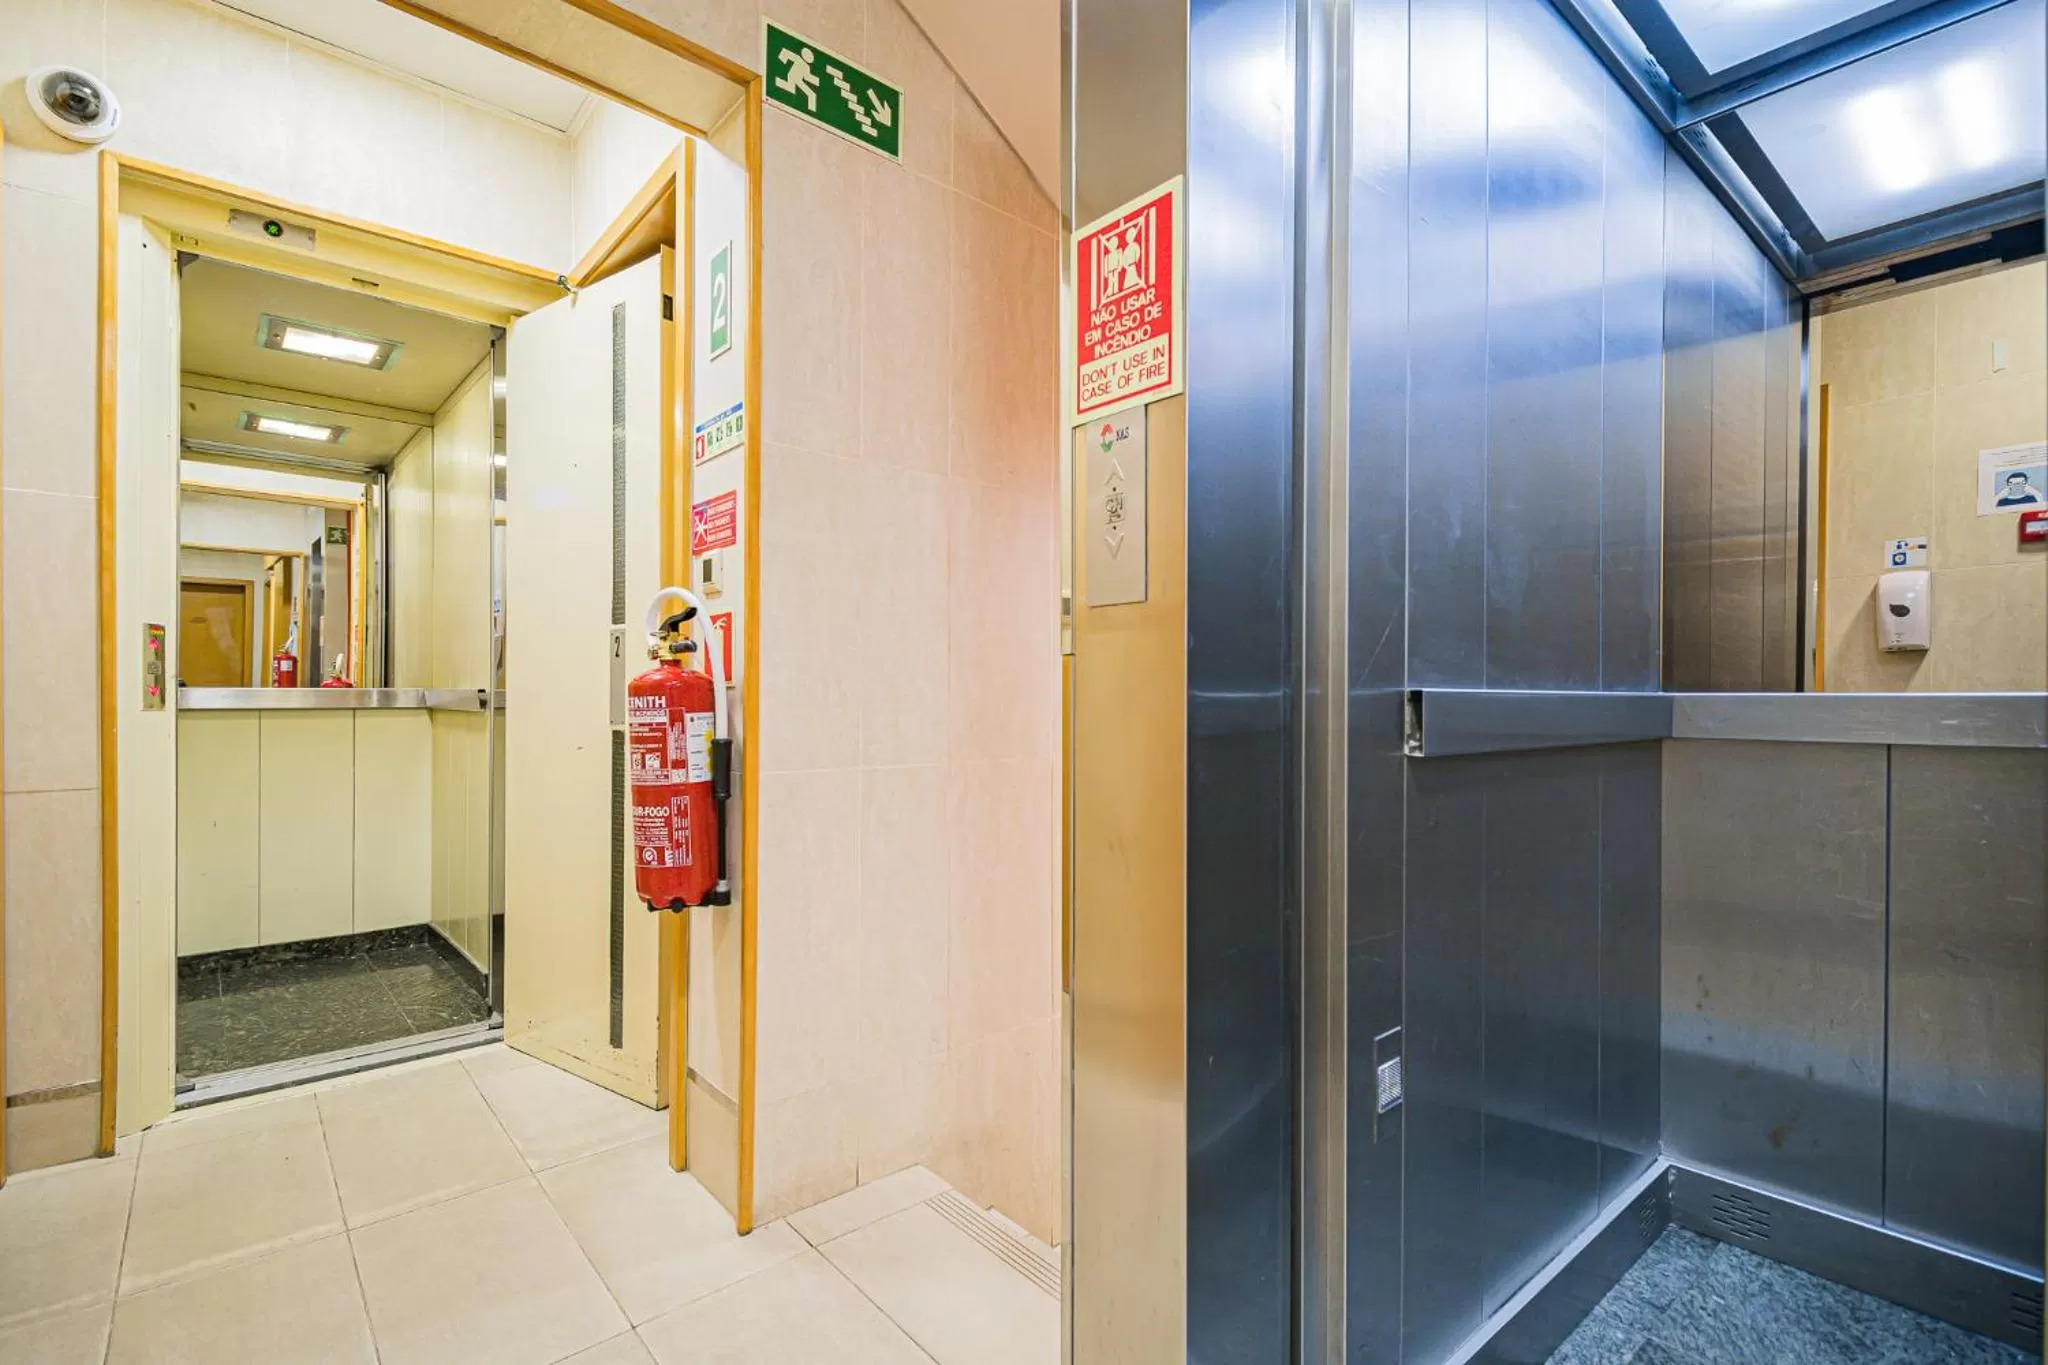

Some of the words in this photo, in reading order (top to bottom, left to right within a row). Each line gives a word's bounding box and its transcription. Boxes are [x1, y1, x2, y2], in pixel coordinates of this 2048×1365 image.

[713, 272, 726, 333] 2
[1120, 287, 1156, 314] USAR
[1084, 327, 1102, 347] EM
[1105, 312, 1140, 337] CASO
[1144, 300, 1162, 322] DE
[1082, 361, 1117, 386] DON'T
[1123, 350, 1148, 371] USE
[1153, 344, 1165, 361] IN
[1082, 380, 1112, 402] CASE
[1117, 372, 1134, 389] OF
[1138, 361, 1166, 382] FIRE
[614, 636, 621, 657] 2
